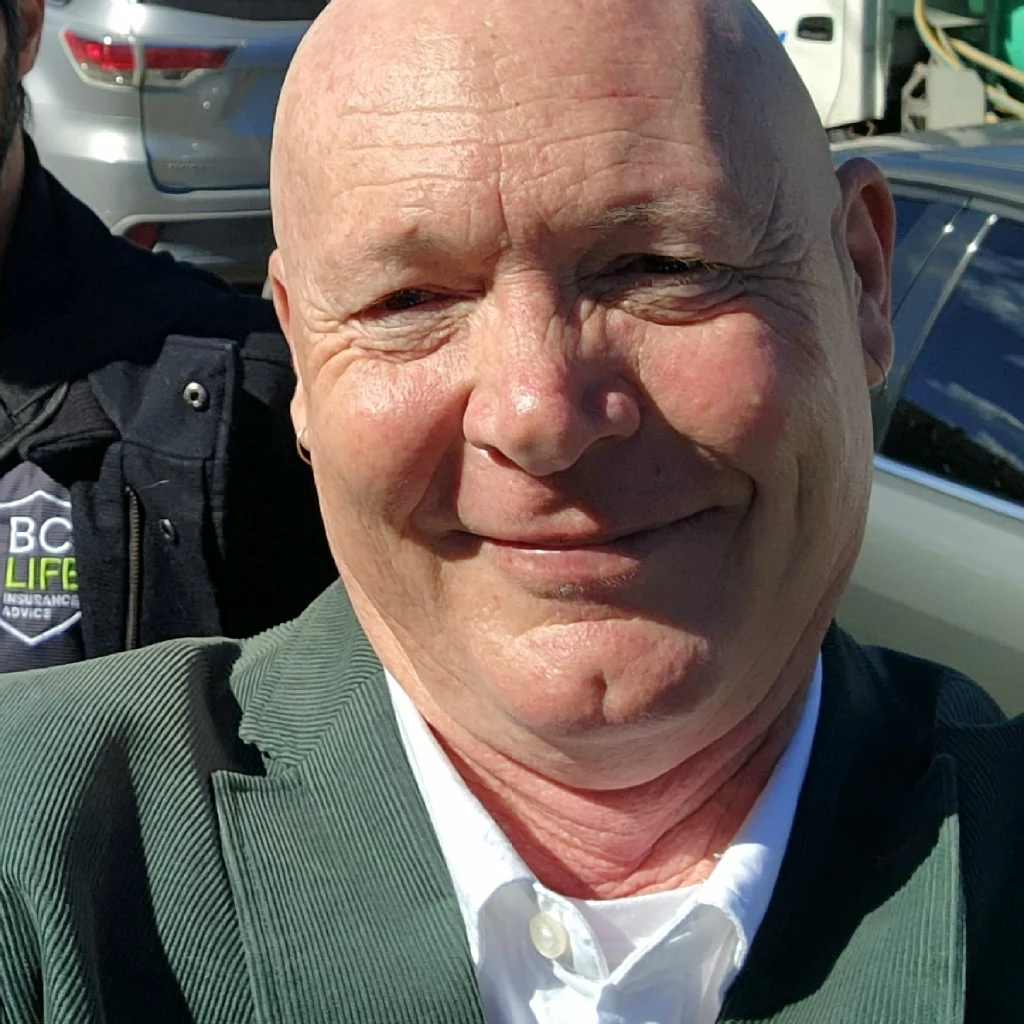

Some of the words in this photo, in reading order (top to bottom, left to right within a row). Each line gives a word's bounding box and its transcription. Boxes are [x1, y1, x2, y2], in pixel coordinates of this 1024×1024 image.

[9, 516, 74, 551] BC
[5, 556, 79, 591] LIFE
[2, 605, 52, 621] ADVICE
[3, 592, 80, 609] INSURANCE
